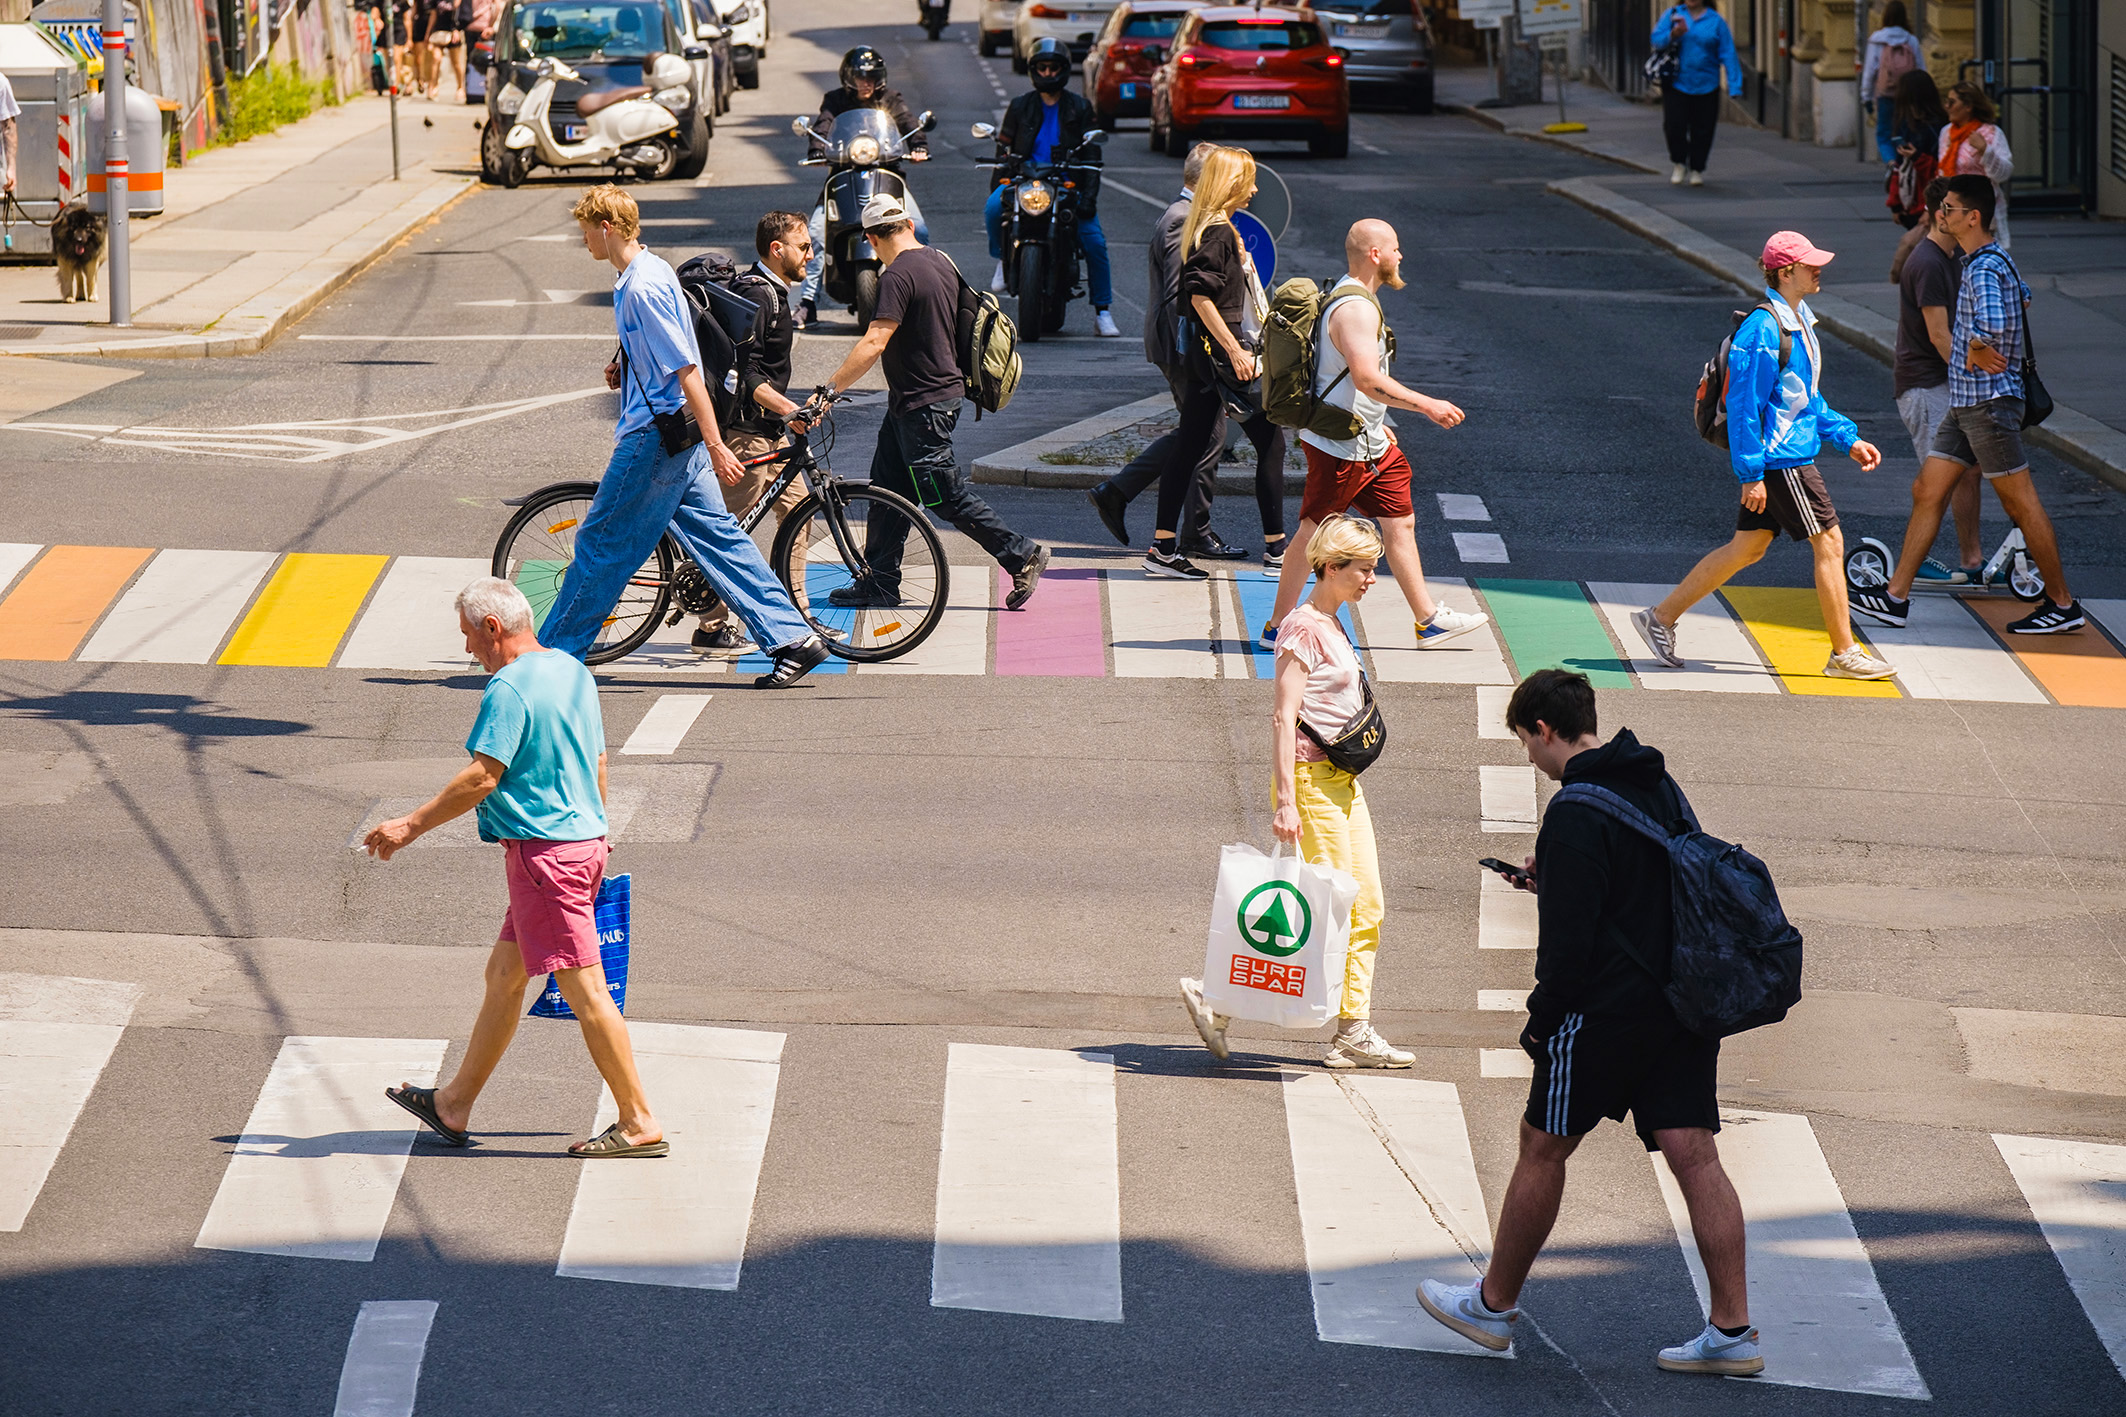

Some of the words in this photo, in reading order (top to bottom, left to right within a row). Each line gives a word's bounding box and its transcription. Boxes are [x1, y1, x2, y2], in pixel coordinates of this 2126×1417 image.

[1123, 85, 1132, 97] L
[1233, 956, 1304, 981] EURO
[1231, 971, 1303, 994] SPAR
